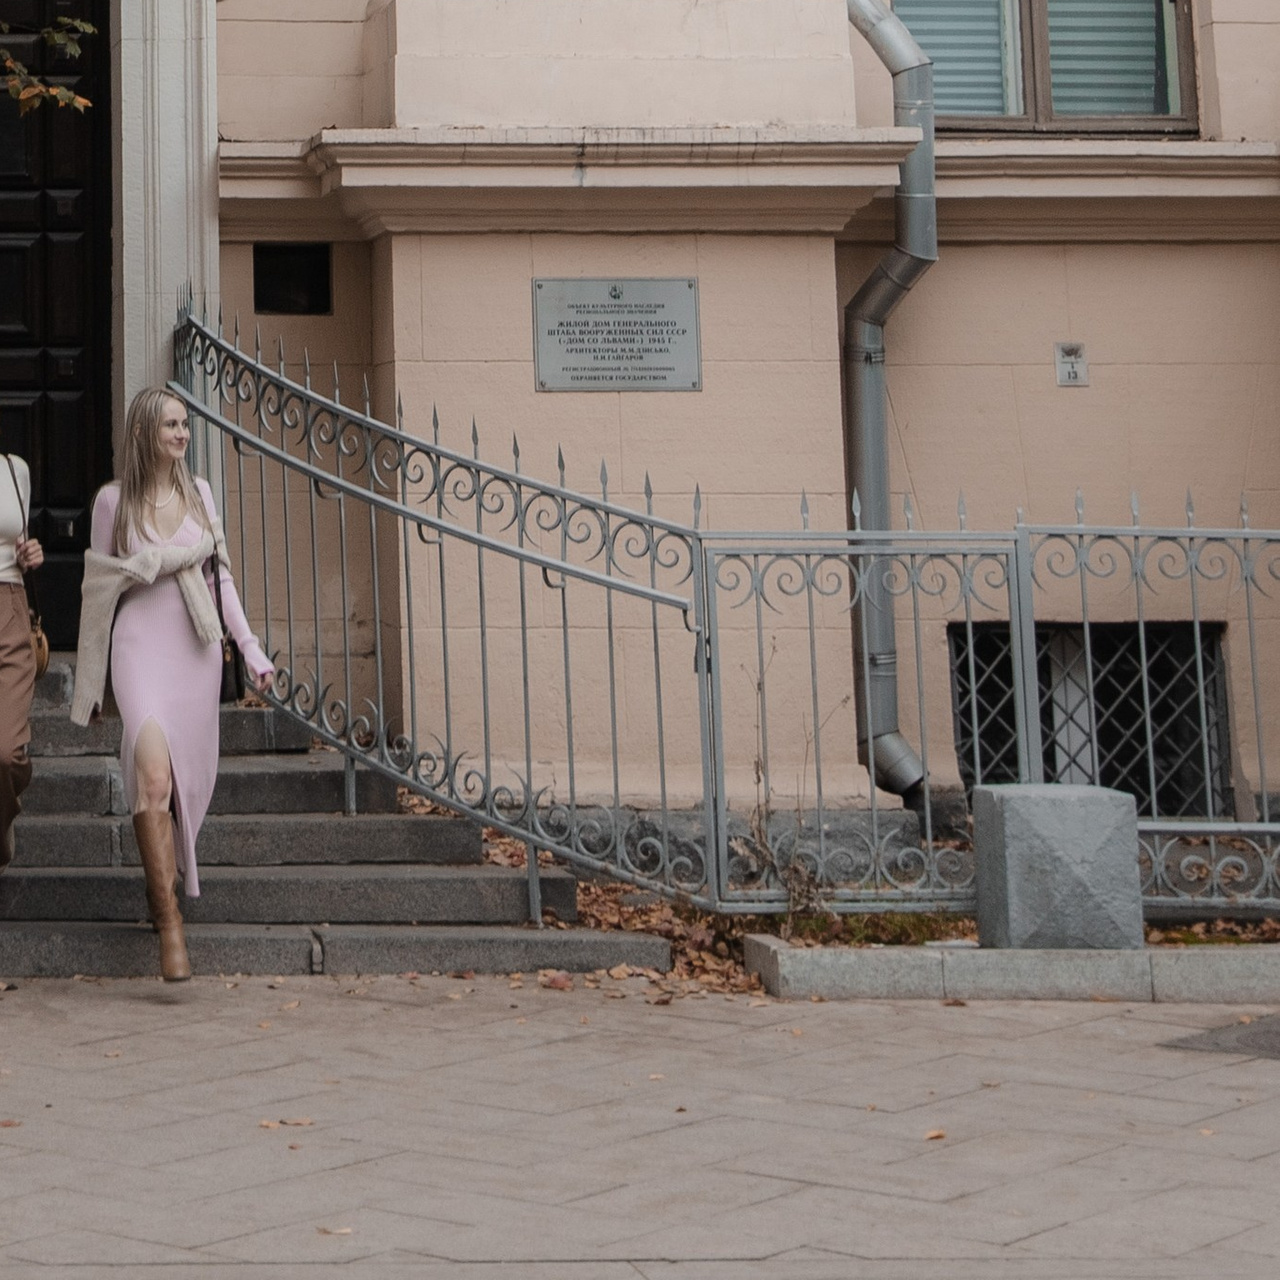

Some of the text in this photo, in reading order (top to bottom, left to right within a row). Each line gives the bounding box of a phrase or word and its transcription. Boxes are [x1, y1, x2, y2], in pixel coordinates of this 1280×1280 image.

[557, 320, 677, 328] ЖИЛОЙ ДОМ ГЕНЕРАЛЬНОГО
[587, 337, 599, 345] СО
